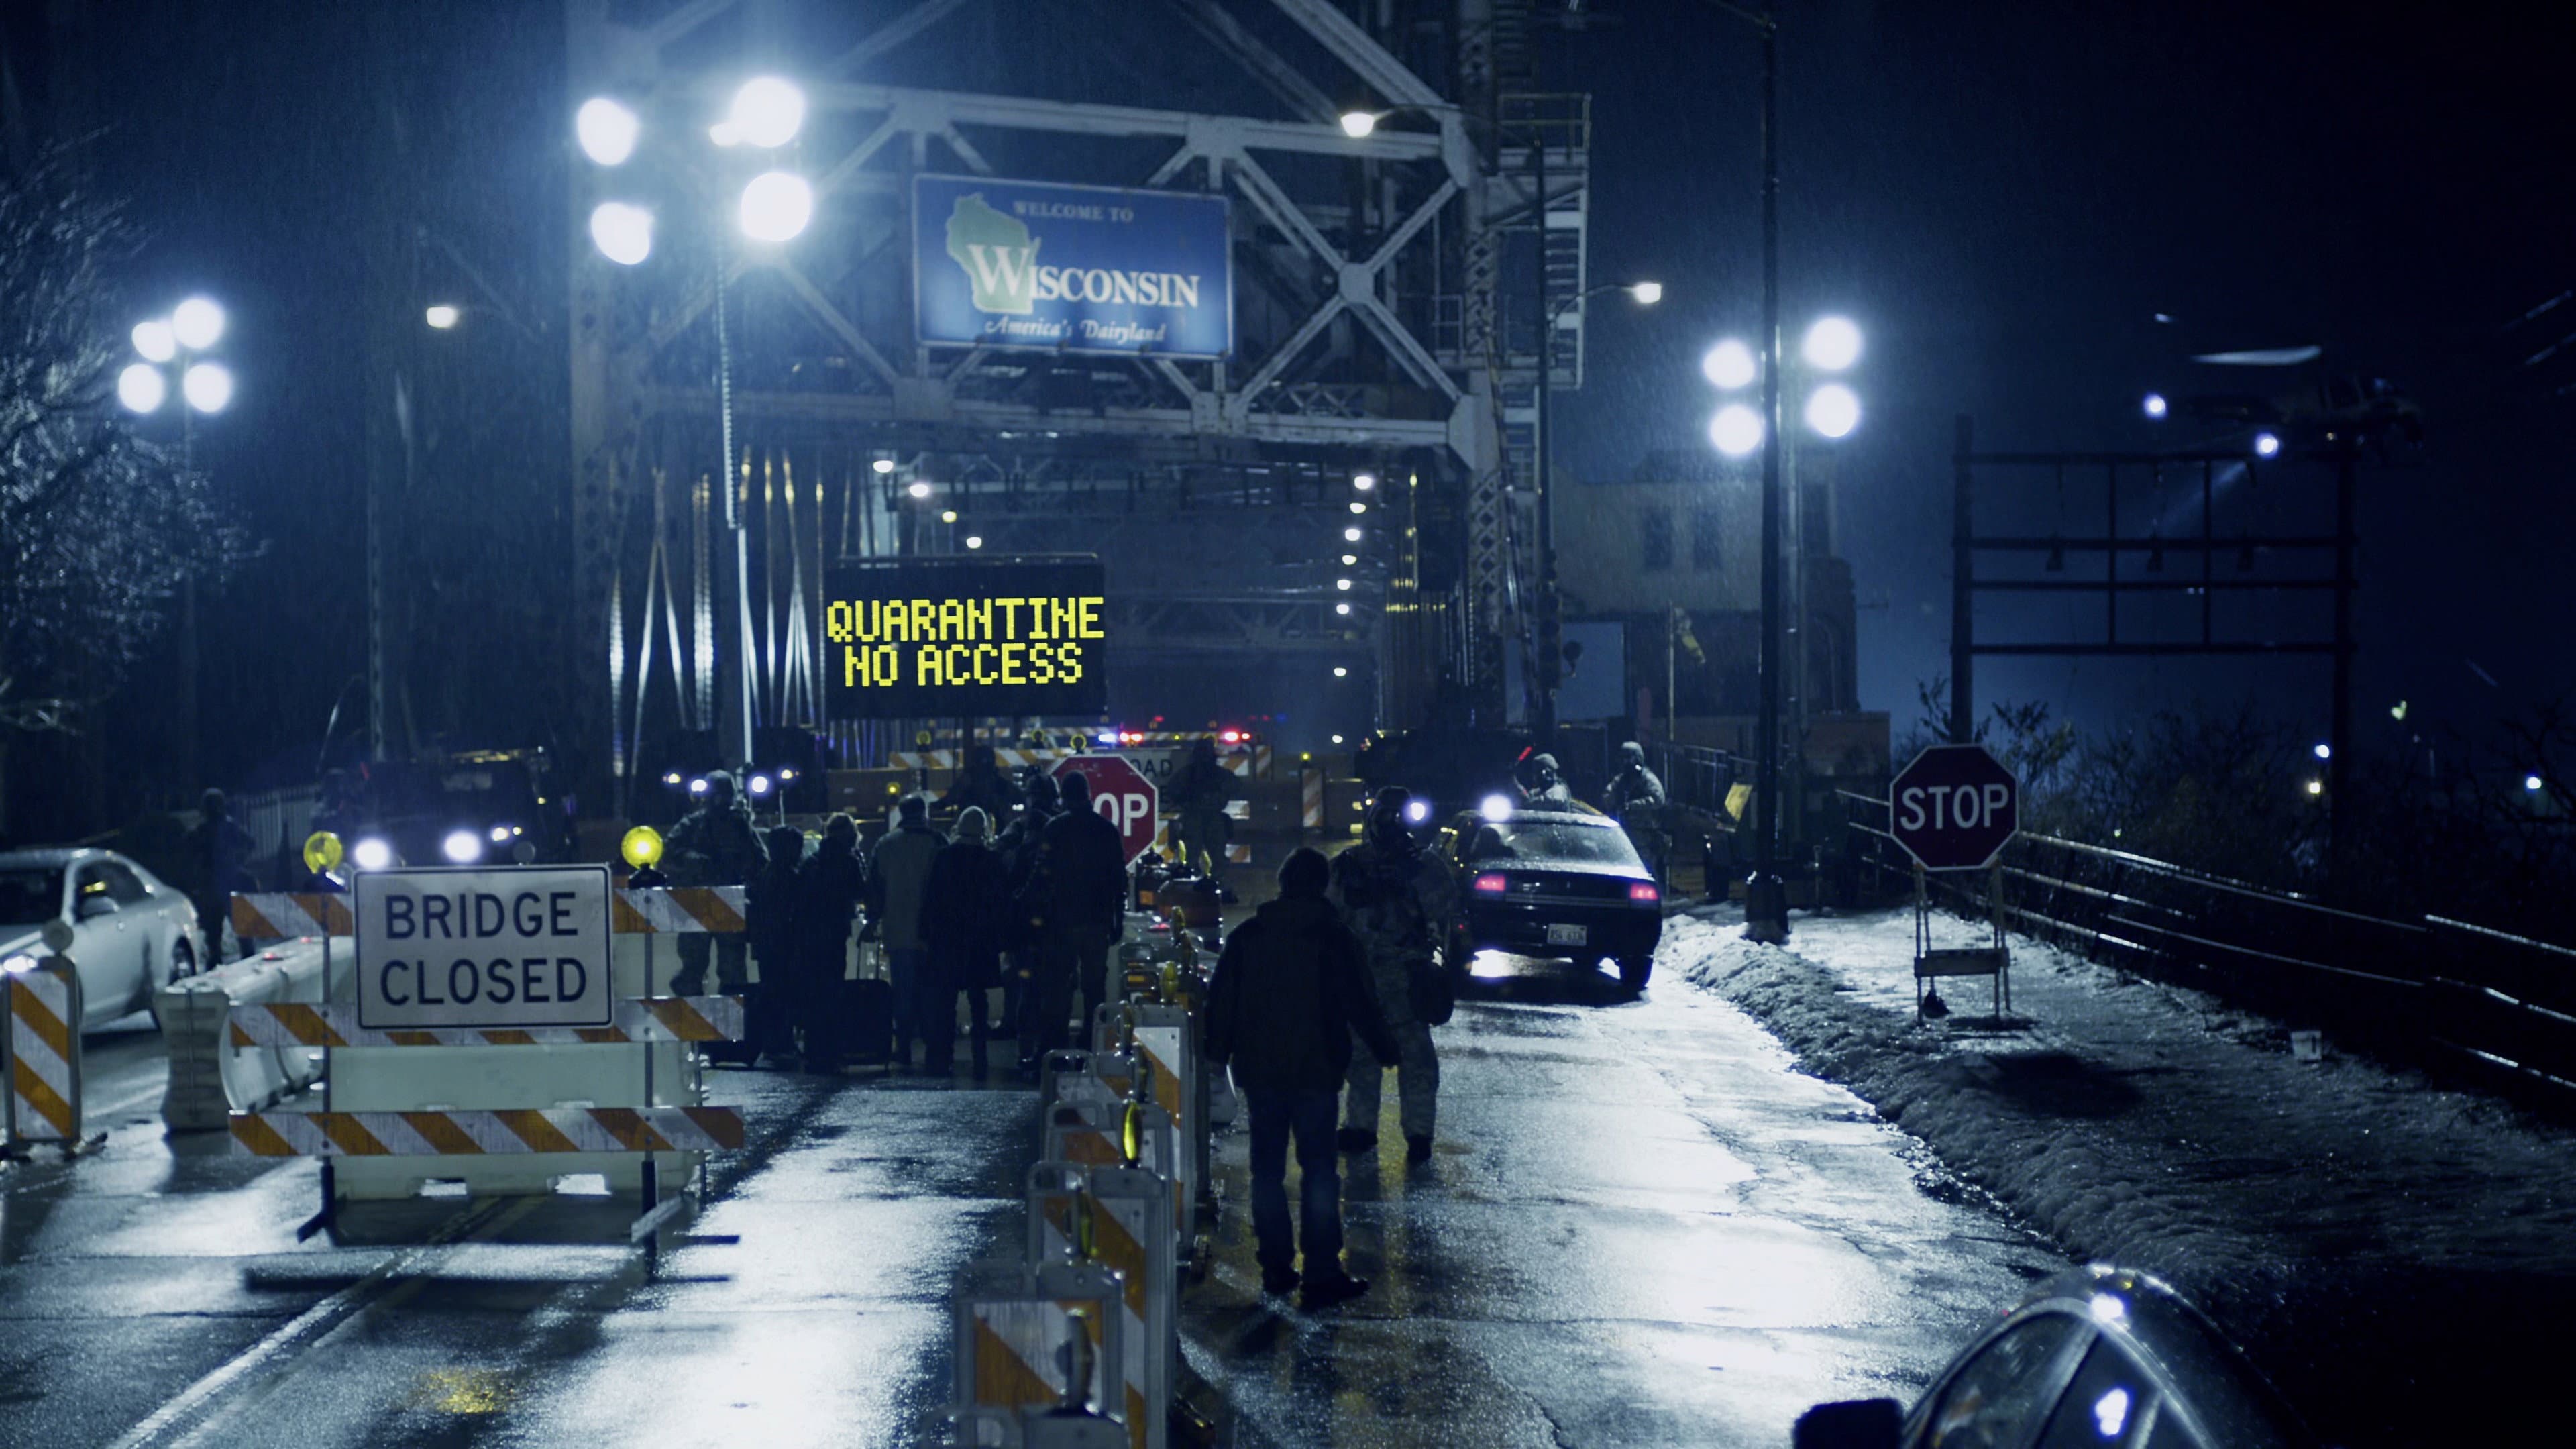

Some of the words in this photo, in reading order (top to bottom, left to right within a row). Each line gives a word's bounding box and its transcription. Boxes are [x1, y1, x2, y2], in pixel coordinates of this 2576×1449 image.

[1014, 201, 1102, 221] WELCOME
[1111, 207, 1134, 222] TO
[967, 244, 1200, 308] WISCONSIN
[985, 316, 1073, 337] America's
[1080, 319, 1167, 345] Dairyland
[827, 596, 1104, 643] QUARANTINE
[845, 645, 898, 687] NO
[917, 642, 1082, 686] ACCESS
[1130, 759, 1173, 777] OAD
[1093, 793, 1149, 837] OP
[1900, 783, 2009, 831] STOP
[385, 891, 578, 939] BRIDGE
[380, 957, 586, 1006] CLOSED
